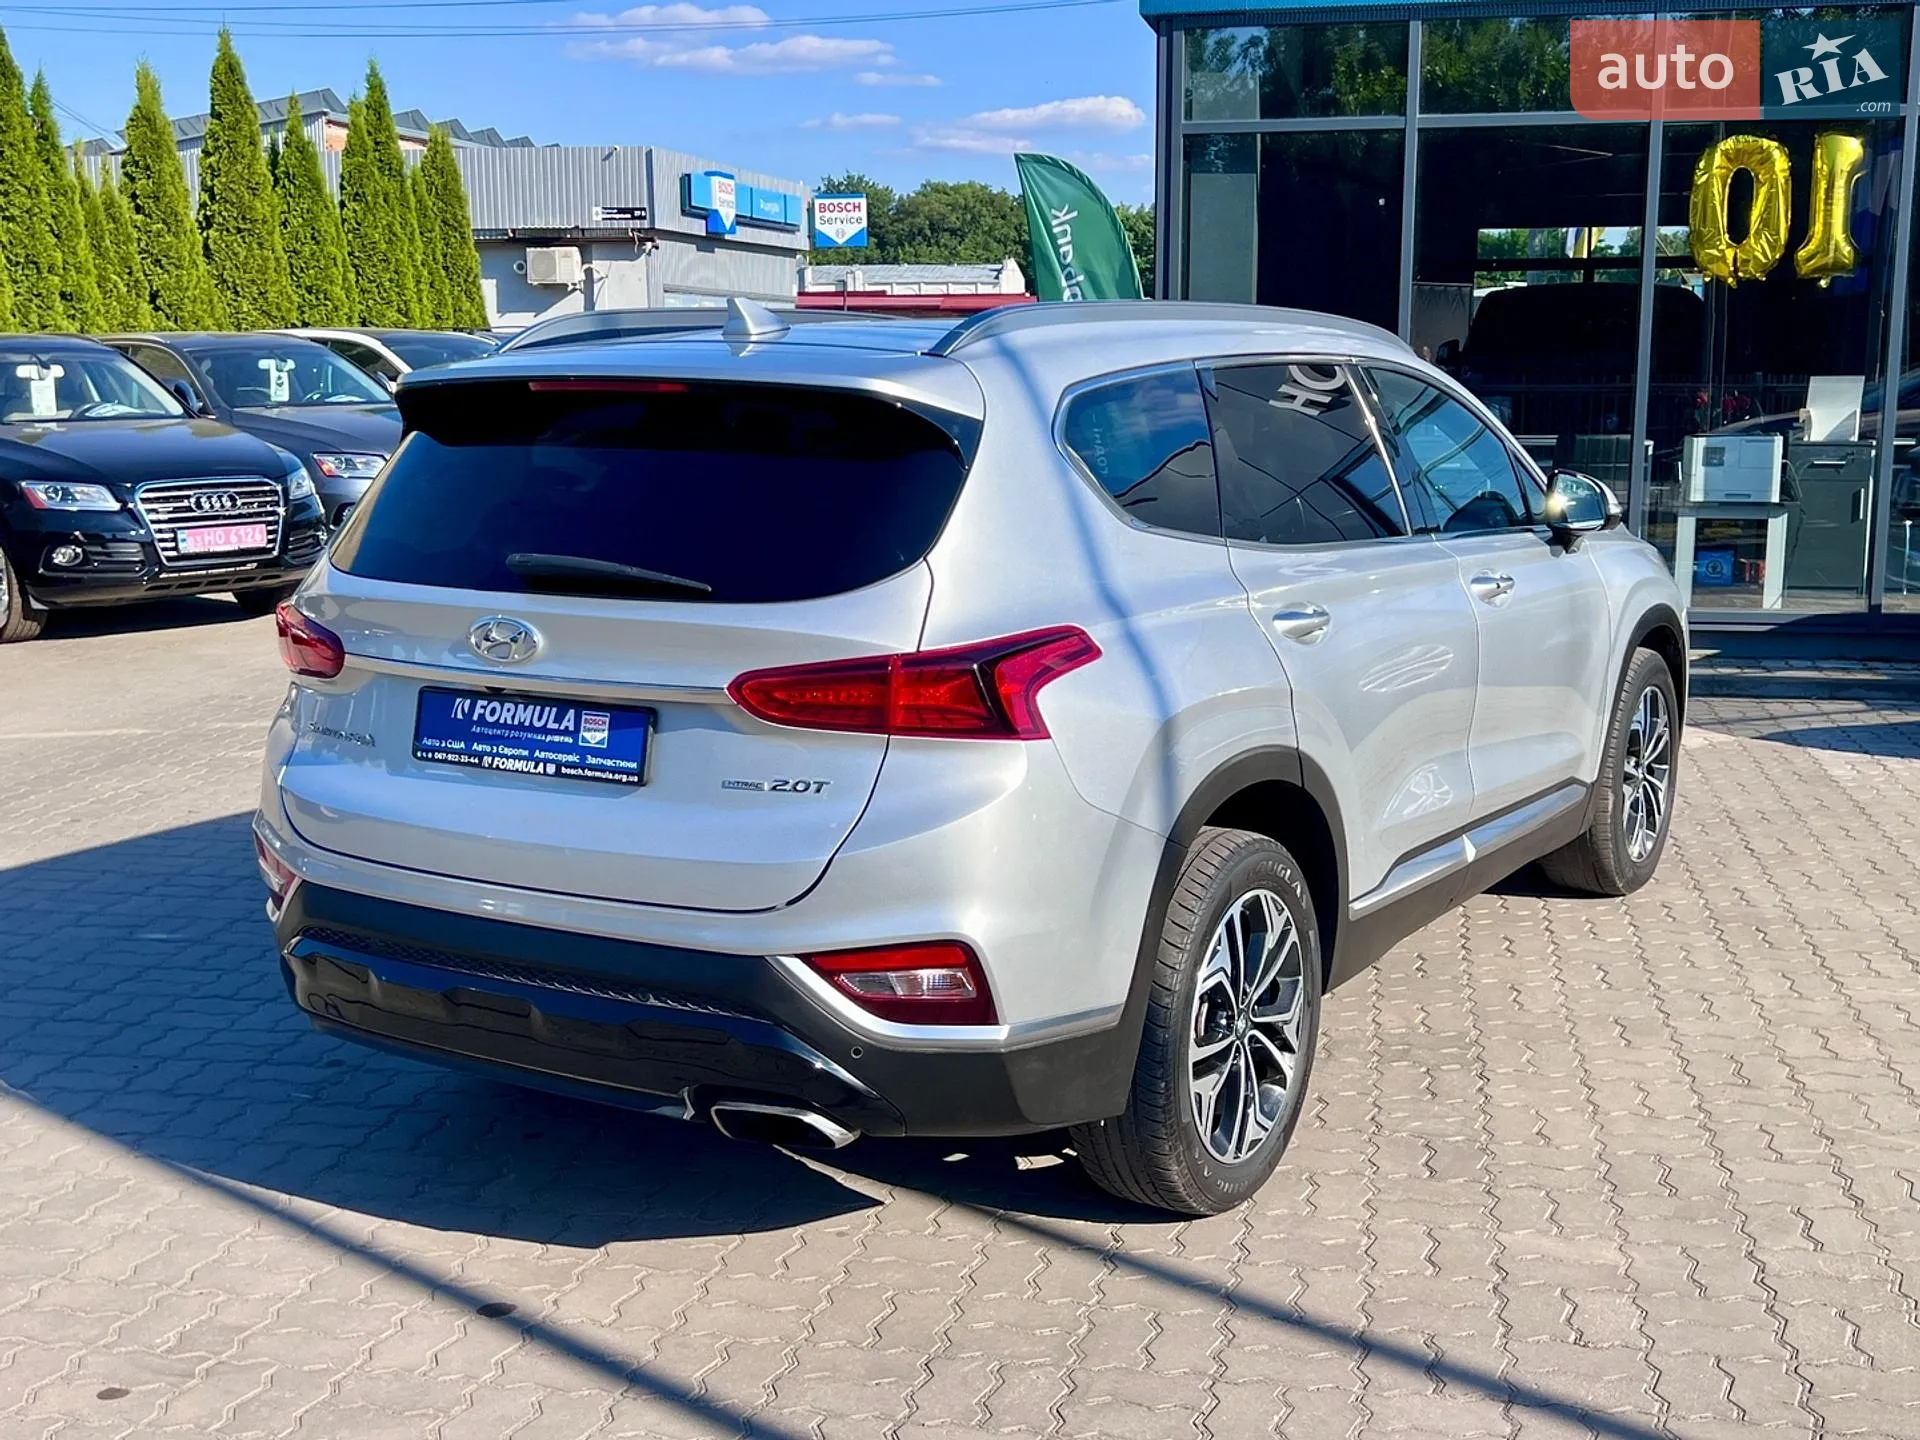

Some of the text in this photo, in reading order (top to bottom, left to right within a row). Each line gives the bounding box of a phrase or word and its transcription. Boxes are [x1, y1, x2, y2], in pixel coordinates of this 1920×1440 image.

[818, 201, 862, 214] BOSCH
[819, 214, 863, 226] Service
[472, 699, 576, 732] FORMULA
[583, 716, 608, 727] BOSCH
[583, 726, 607, 734] Service
[422, 736, 440, 747] Авто
[446, 738, 466, 750] США
[472, 741, 492, 753] Авто
[534, 748, 581, 763] Автосервіс
[586, 754, 638, 769] Запчастини
[491, 756, 545, 775] FORMULA
[560, 765, 639, 783] bosch.formula.org.ua
